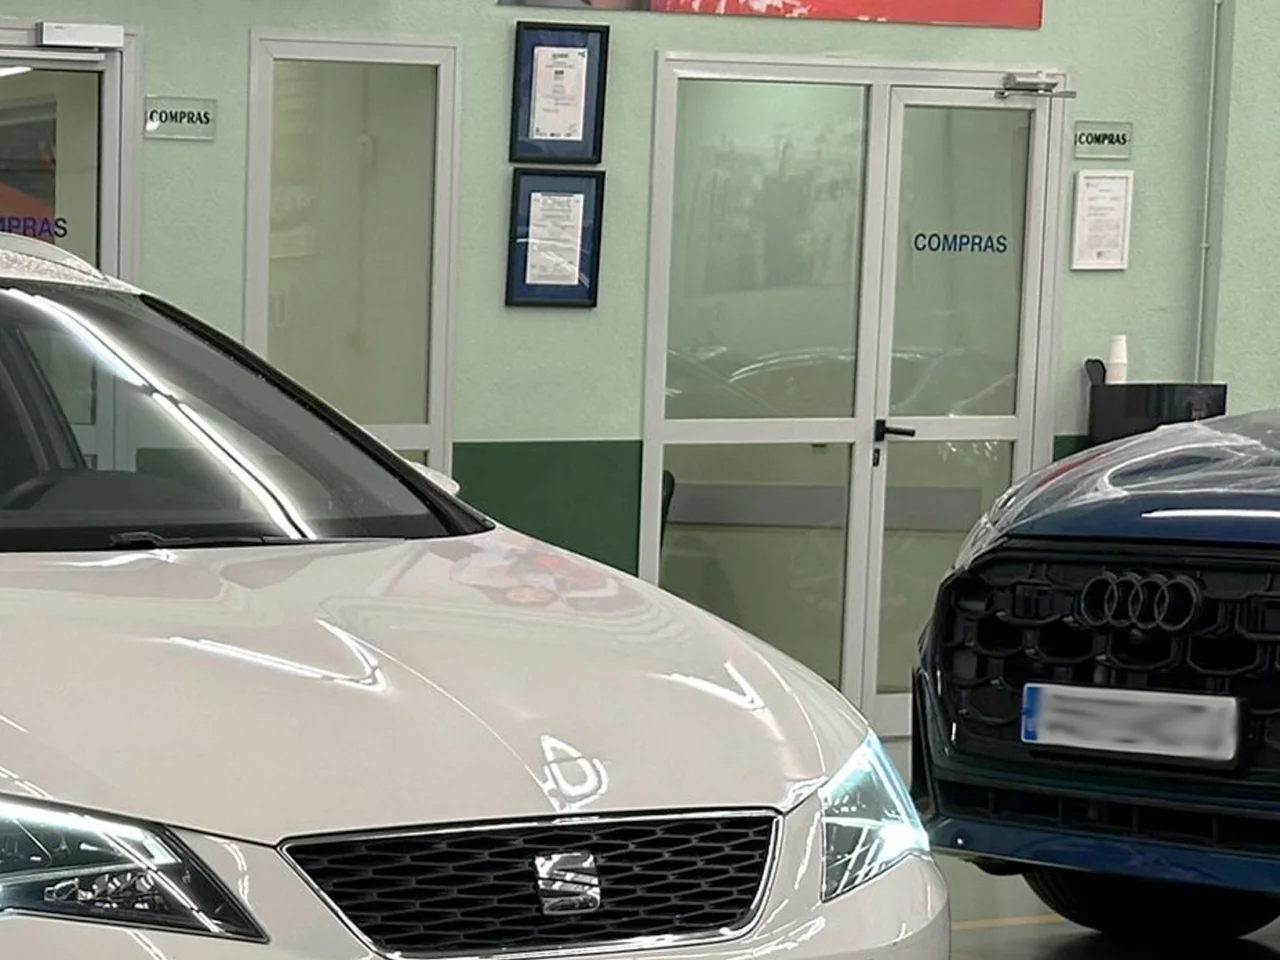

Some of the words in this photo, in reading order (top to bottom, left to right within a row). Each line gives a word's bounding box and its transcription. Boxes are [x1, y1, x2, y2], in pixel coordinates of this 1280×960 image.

[149, 109, 210, 125] COMPRAS
[1078, 132, 1127, 145] COMPRAS
[914, 233, 1007, 253] COMPRAS
